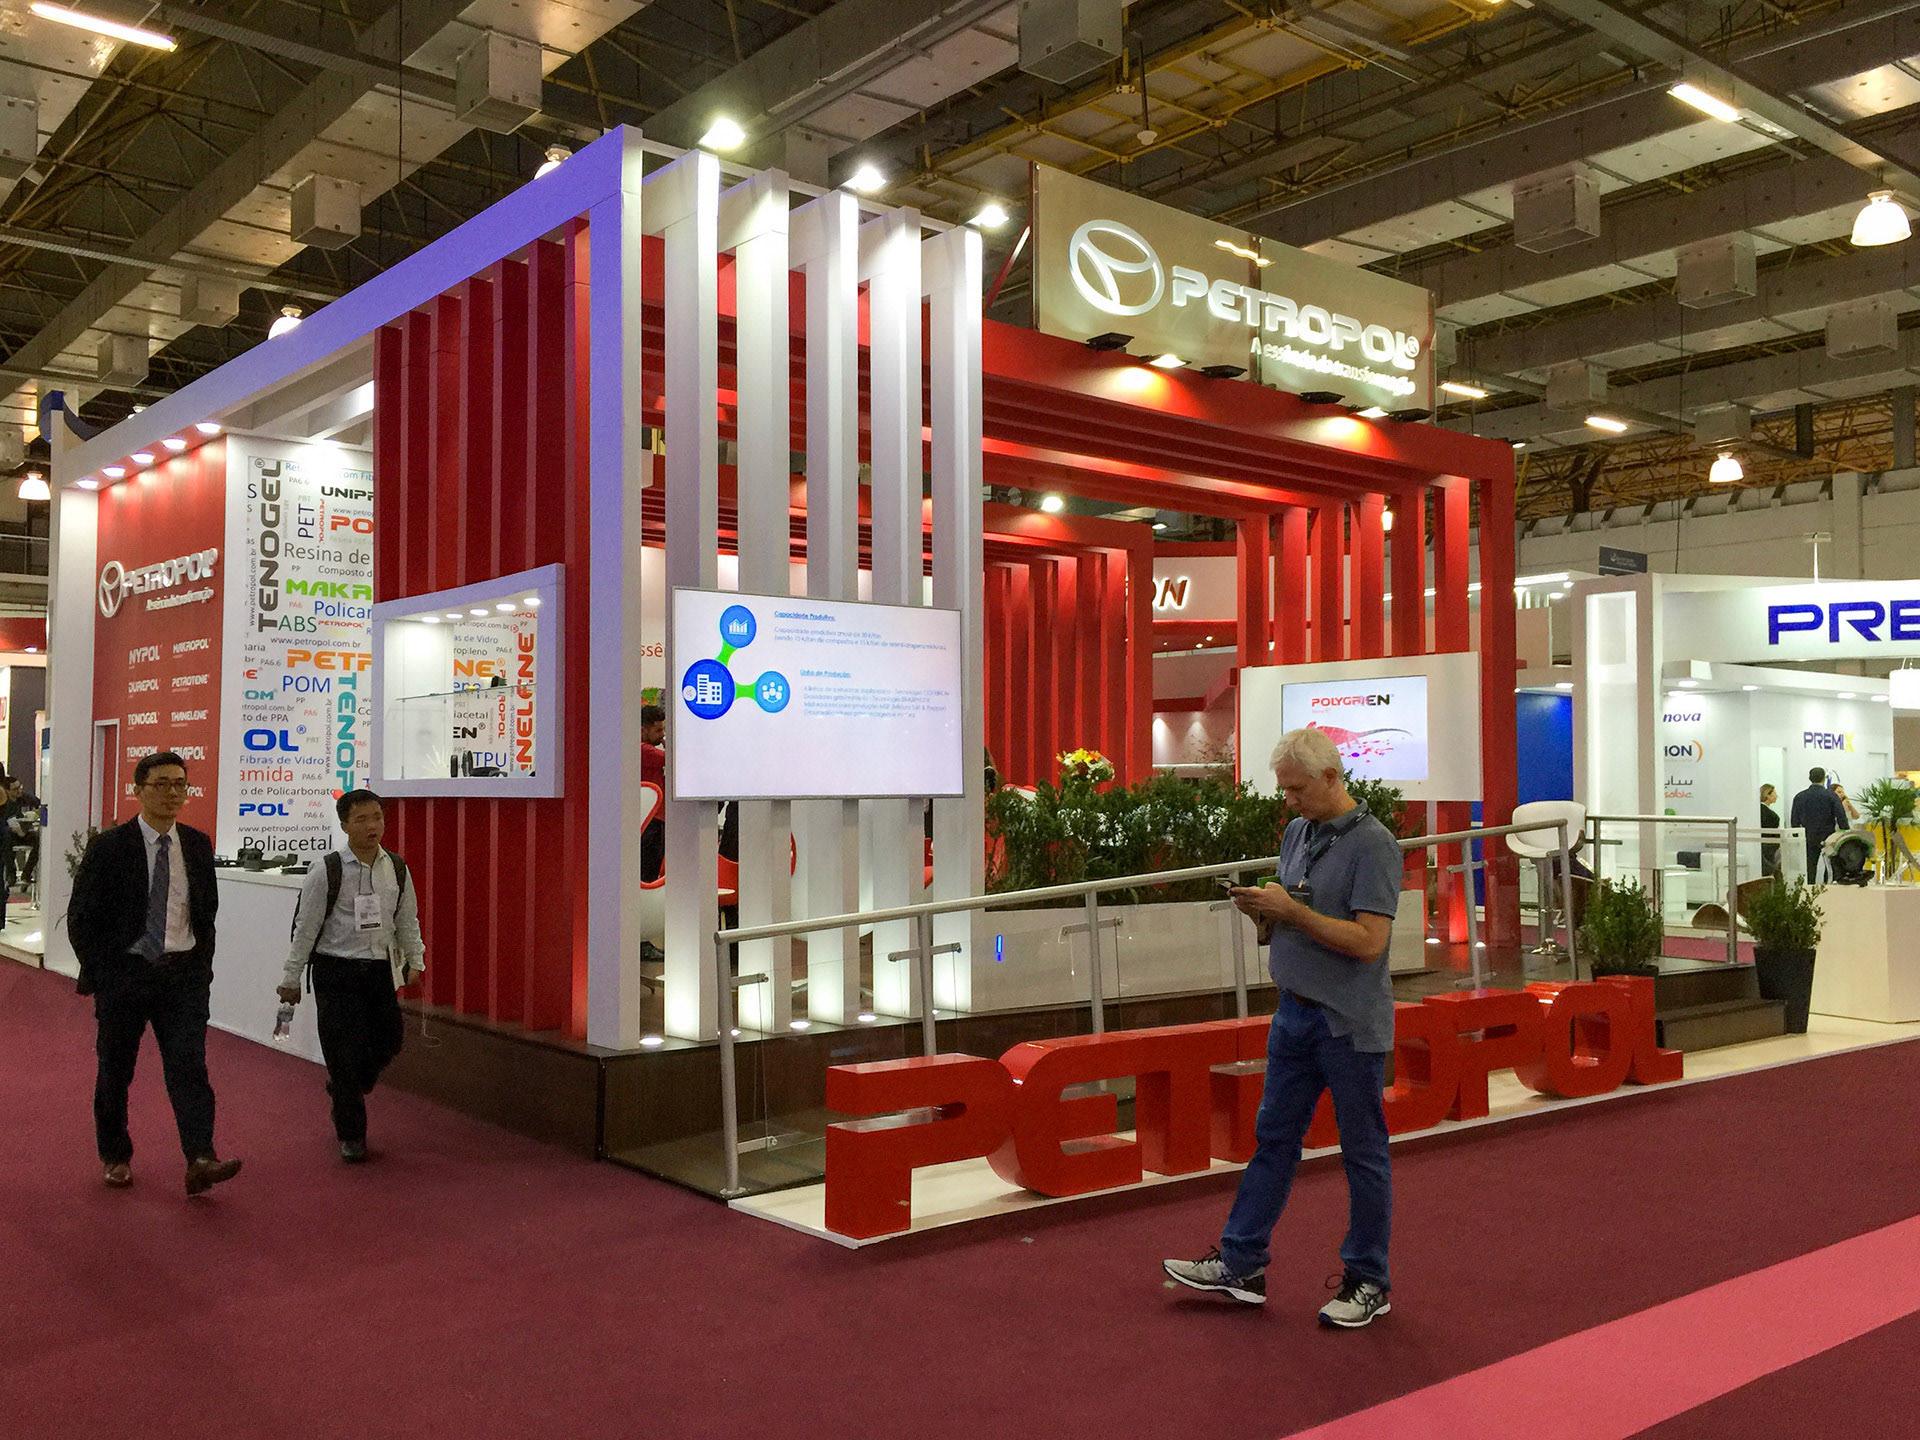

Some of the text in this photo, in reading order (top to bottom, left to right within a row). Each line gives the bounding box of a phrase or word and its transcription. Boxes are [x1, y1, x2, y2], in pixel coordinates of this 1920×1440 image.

[1172, 265, 1416, 371] PETROPOL
[298, 504, 314, 538] PET
[258, 461, 281, 633] TENOGEL
[284, 543, 370, 565] Resina de
[318, 565, 363, 578] Composto
[279, 614, 317, 633] ABS
[1768, 600, 1920, 645] PRE
[270, 637, 361, 649] www.petropol.com.br
[282, 675, 331, 693] POM
[256, 713, 268, 721] de
[271, 713, 289, 722] PPA
[1663, 712, 1702, 723] nova
[243, 728, 299, 752] OL
[240, 755, 325, 765] Fibras de Vidro
[473, 752, 507, 768] TPU
[250, 787, 264, 796] de
[239, 803, 290, 817] POL
[243, 833, 334, 853] Poliacetal
